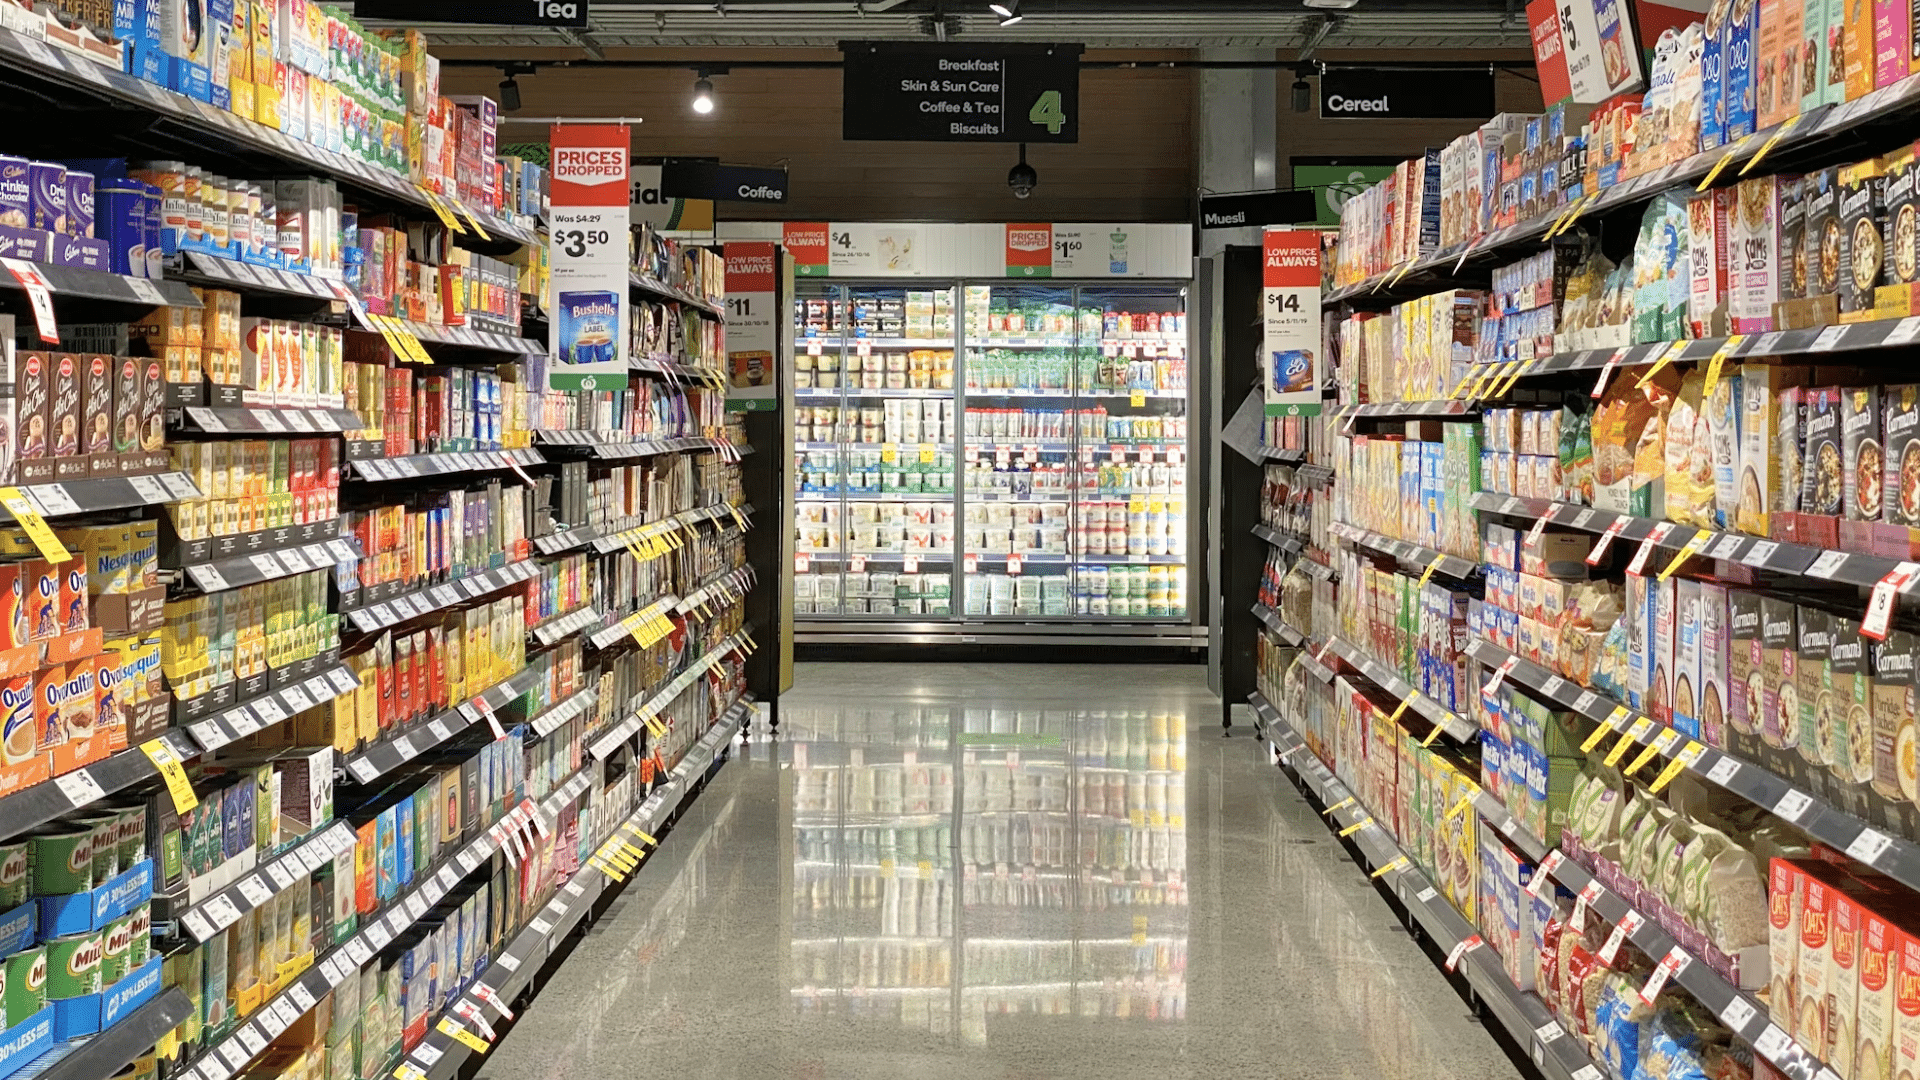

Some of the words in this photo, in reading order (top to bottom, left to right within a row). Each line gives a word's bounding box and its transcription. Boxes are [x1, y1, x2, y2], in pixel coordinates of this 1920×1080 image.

[534, 0, 577, 19] Tea
[938, 59, 1000, 72] Breakfast
[901, 80, 928, 92] Skin
[930, 80, 940, 92] &
[942, 81, 967, 92] Sun
[969, 81, 1000, 93] Care
[919, 101, 960, 113] Coffee
[963, 101, 973, 113] &
[975, 102, 1000, 113] Tea
[1328, 95, 1390, 112] Cereal
[1029, 90, 1066, 134] 4
[950, 123, 999, 135] Biscuits
[557, 151, 622, 165] PRICES
[557, 165, 623, 176] DROPPED
[738, 184, 783, 200] Coffee
[555, 214, 574, 223] Was
[576, 214, 601, 223] $4.29
[1204, 212, 1246, 226] Muesli
[786, 238, 827, 247] ALWAYS
[832, 232, 851, 249] $4
[1267, 248, 1289, 256] LOW
[1290, 248, 1317, 256] PRICE
[747, 256, 773, 264] PRICE
[1267, 256, 1318, 267] ALWAYS
[727, 264, 773, 274] ALWAYS
[573, 302, 616, 318] Bushells
[727, 298, 750, 316] $11
[1268, 294, 1300, 313] $14
[584, 325, 605, 333] LABEL
